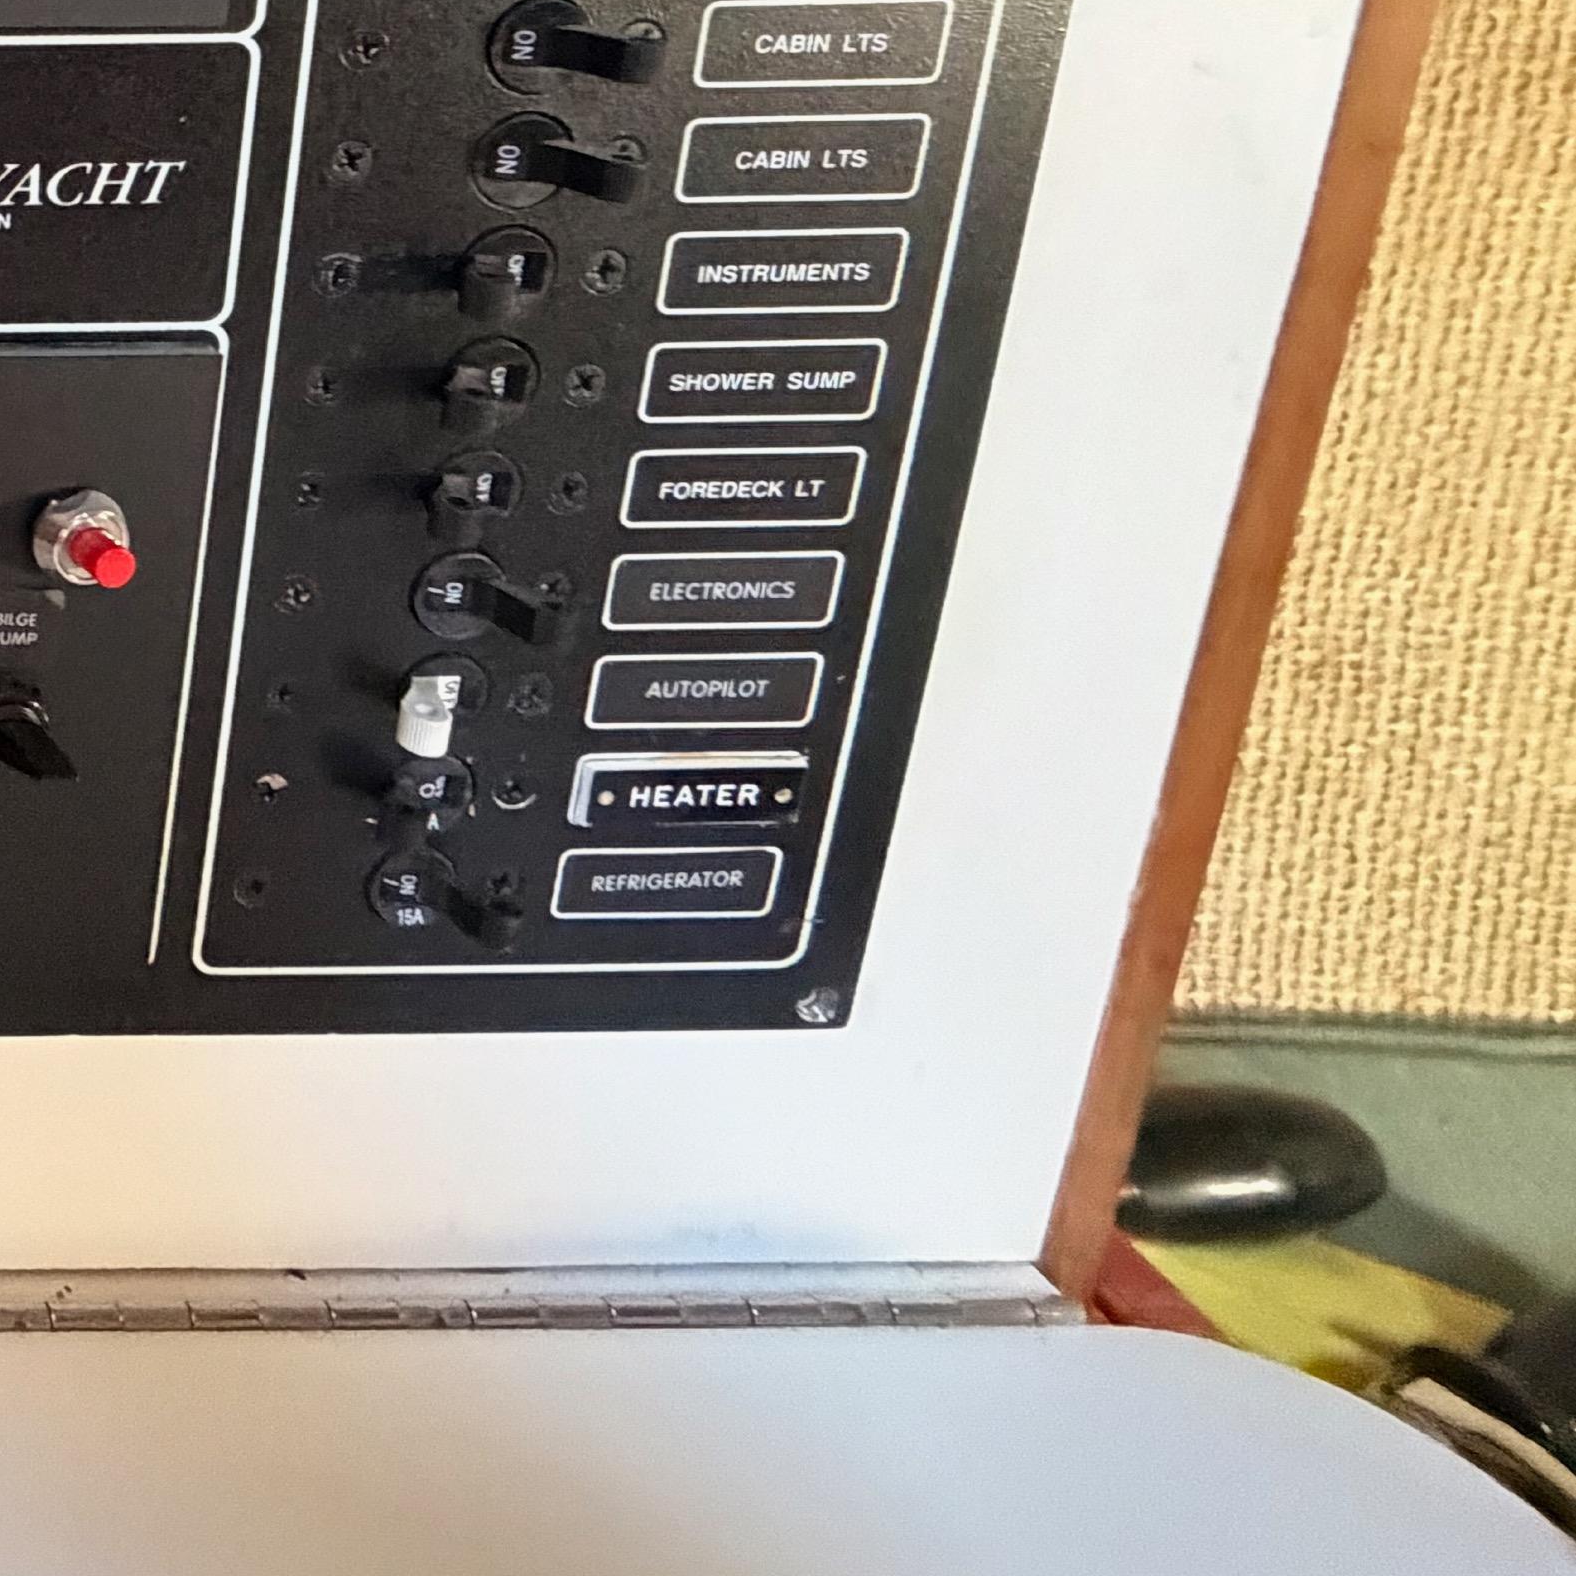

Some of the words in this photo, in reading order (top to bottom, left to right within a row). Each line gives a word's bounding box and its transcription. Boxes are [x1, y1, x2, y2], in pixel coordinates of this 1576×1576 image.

[755, 34, 831, 55] CABIN
[842, 33, 890, 53] LTS
[735, 150, 811, 171] CABIN
[822, 148, 869, 168] LTS
[697, 262, 871, 285] INSTRUMENTS
[668, 372, 775, 393] SHOWER
[787, 371, 857, 390] SUMP
[659, 480, 784, 501] FOREDECK
[795, 479, 825, 497] LT
[649, 580, 796, 602] ELECTRONICS
[645, 679, 770, 699] AUTOPILOT
[629, 784, 760, 809] HEATER
[591, 869, 745, 892] REFRIGERATOR
[397, 908, 425, 927] 15A
